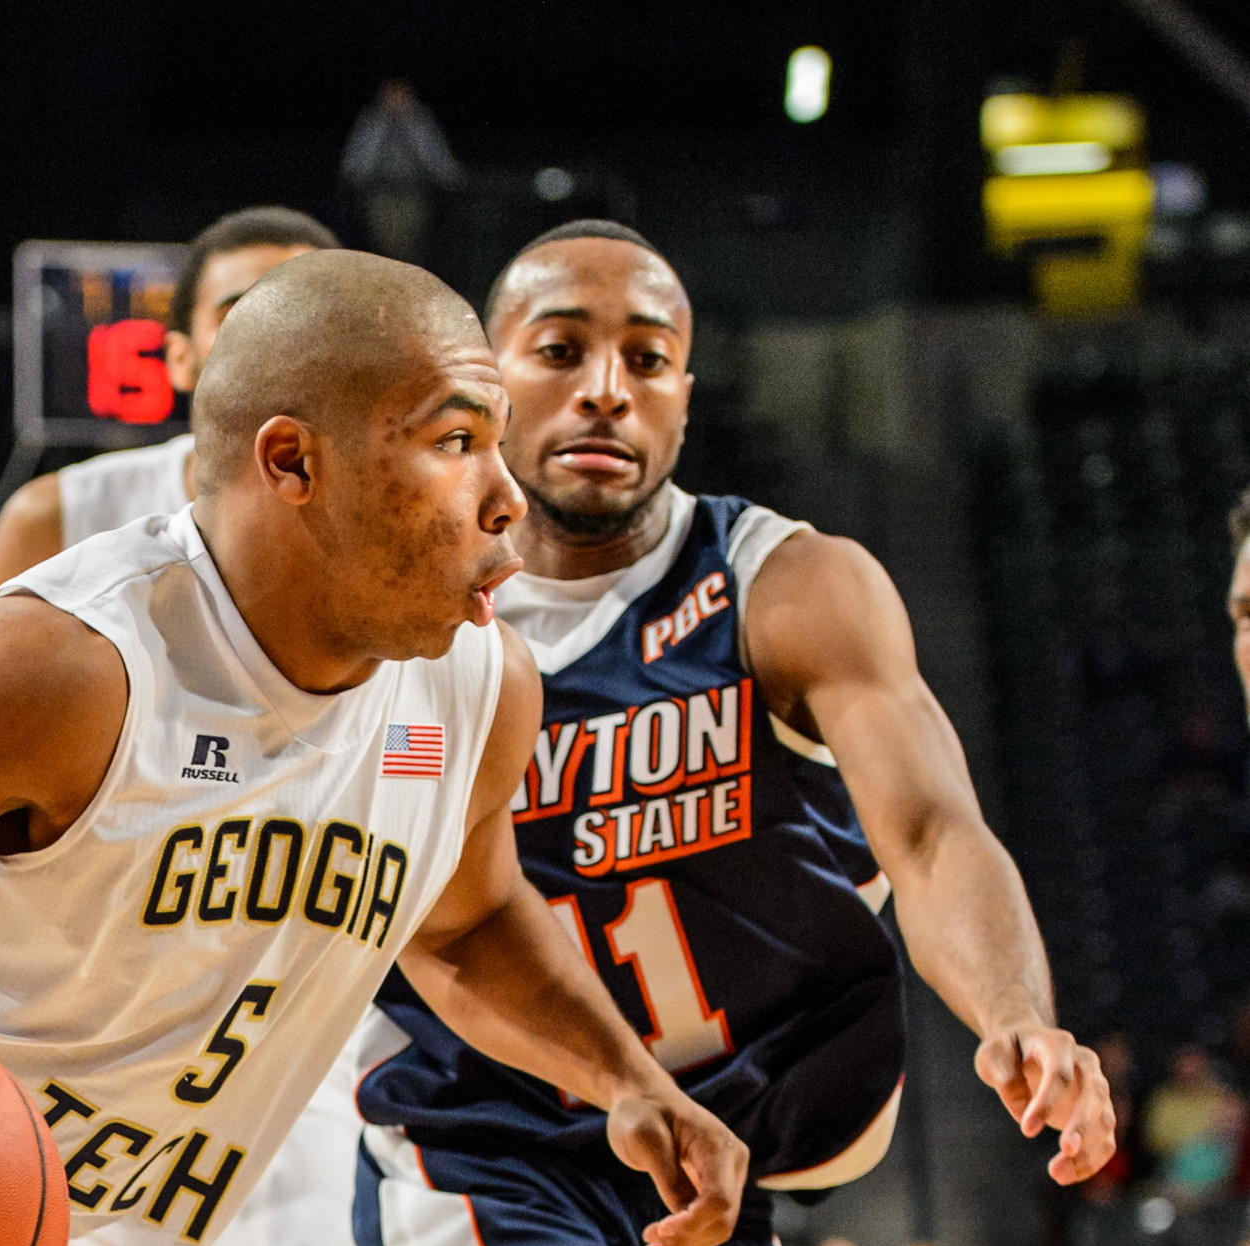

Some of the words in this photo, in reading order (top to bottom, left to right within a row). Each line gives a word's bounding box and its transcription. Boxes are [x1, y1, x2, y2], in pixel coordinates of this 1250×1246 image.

[642, 572, 730, 665] PBC
[181, 767, 240, 784] RUSSELL
[191, 734, 230, 768] R
[509, 678, 753, 824] YTON
[573, 774, 753, 878] STATE
[170, 979, 282, 1108] 5
[547, 877, 736, 1109] 1
[38, 1077, 248, 1244] TECH
